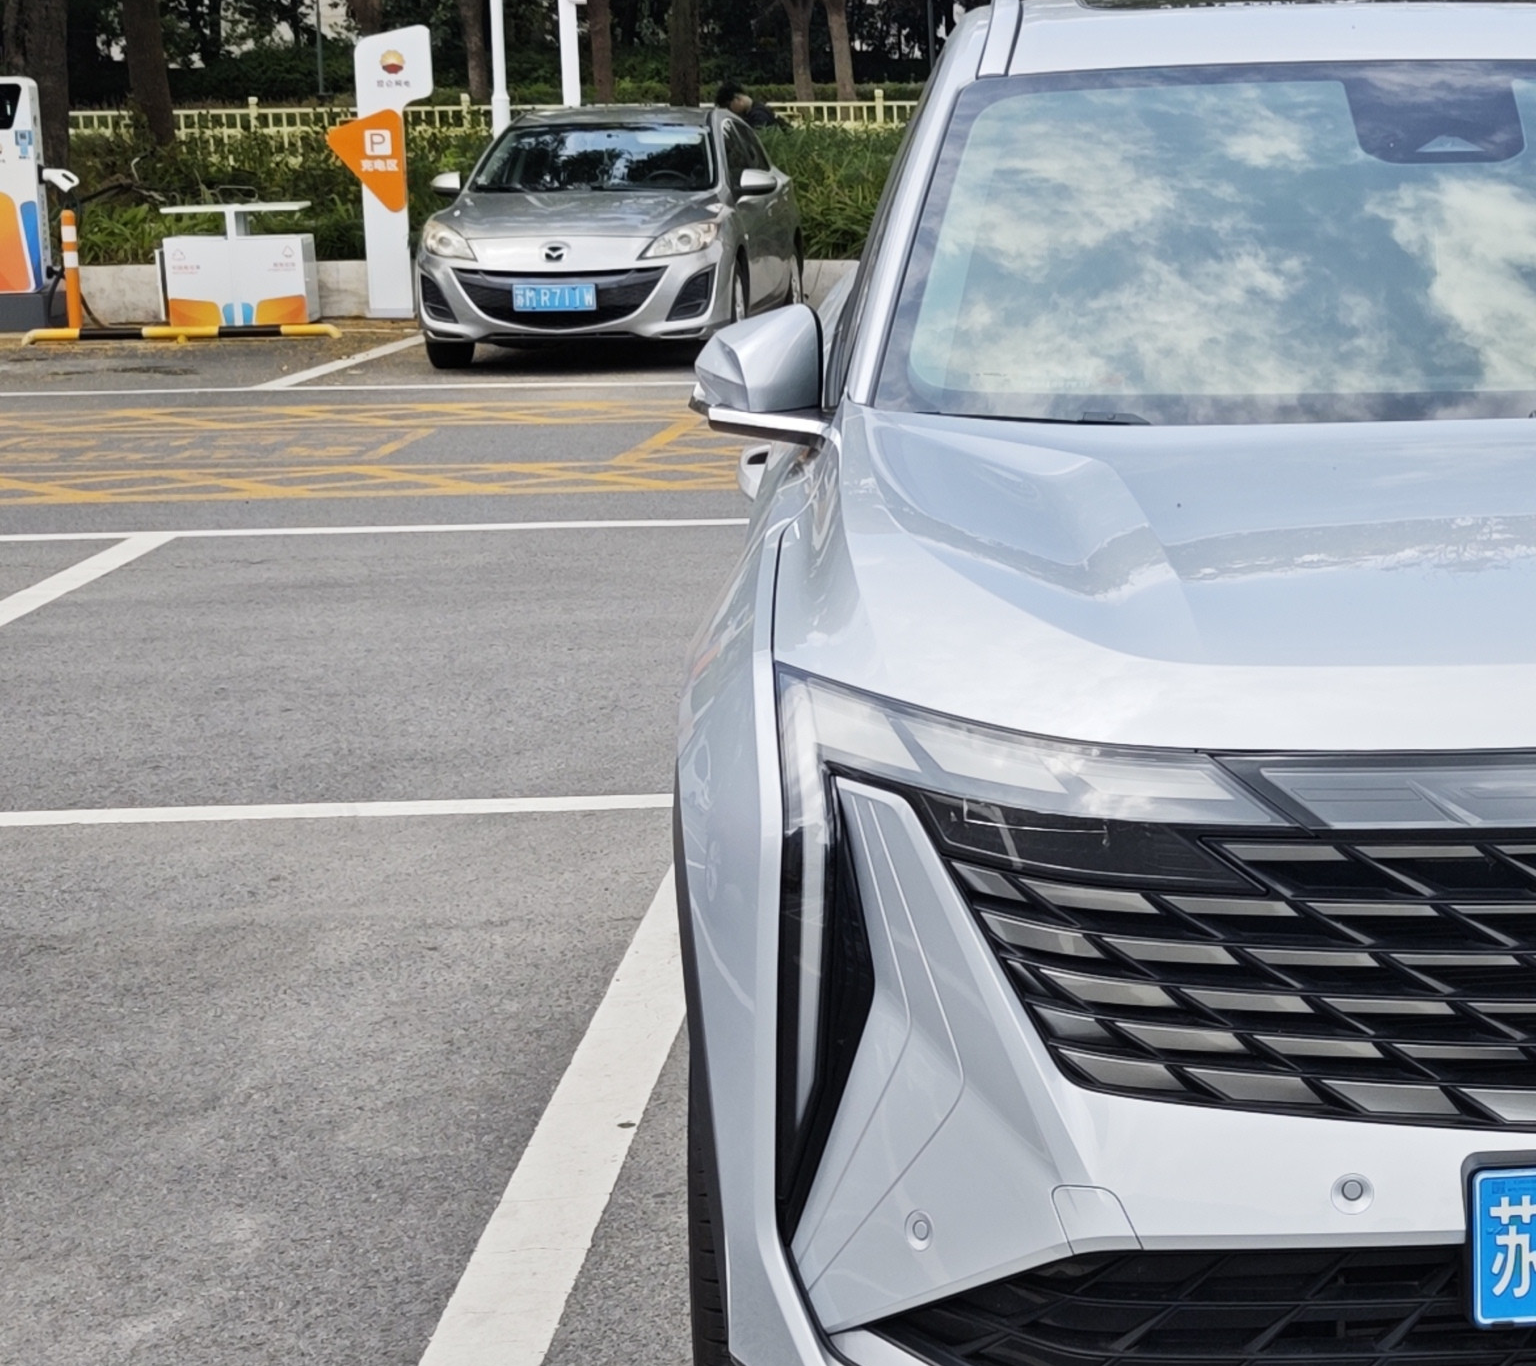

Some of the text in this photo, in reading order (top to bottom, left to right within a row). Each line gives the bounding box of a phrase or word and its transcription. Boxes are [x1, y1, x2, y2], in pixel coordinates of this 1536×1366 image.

[369, 132, 386, 153] P
[360, 158, 399, 172] 充电区
